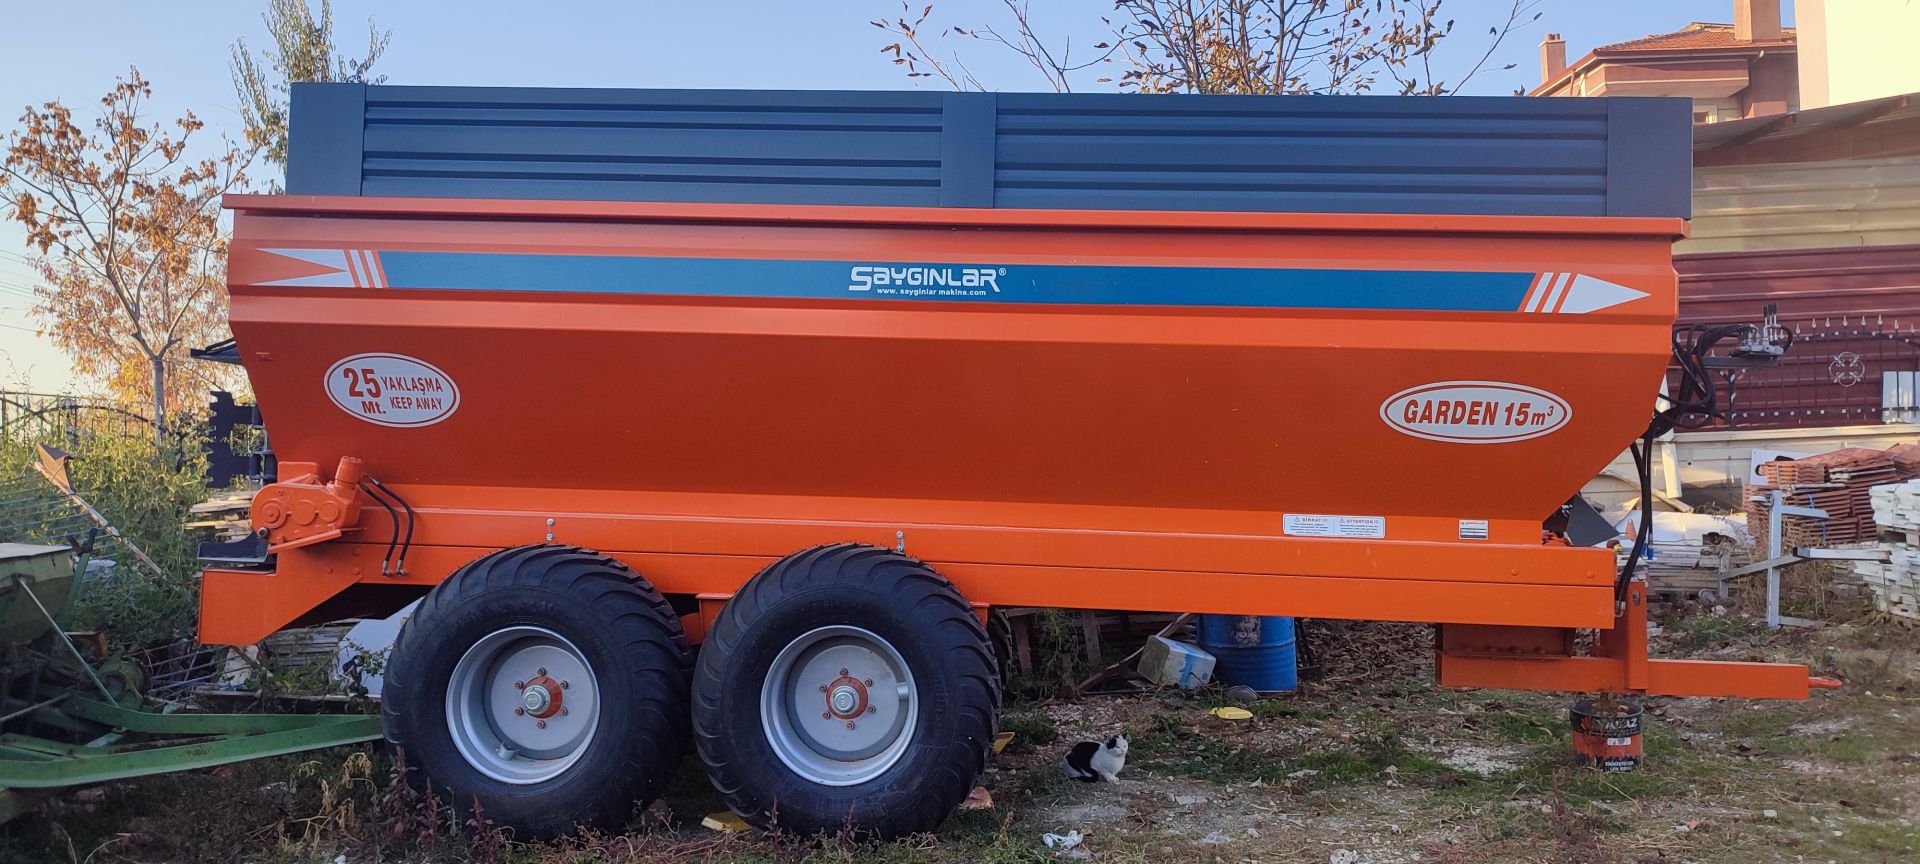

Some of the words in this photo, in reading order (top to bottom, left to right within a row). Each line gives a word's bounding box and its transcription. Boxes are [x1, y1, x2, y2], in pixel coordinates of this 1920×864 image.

[343, 367, 382, 399] 25
[380, 375, 444, 395] YAKLAŞMA
[361, 400, 387, 415] Mt.
[389, 396, 413, 410] KEEP
[415, 397, 443, 411] AWAY
[1403, 399, 1499, 426] GARDEN
